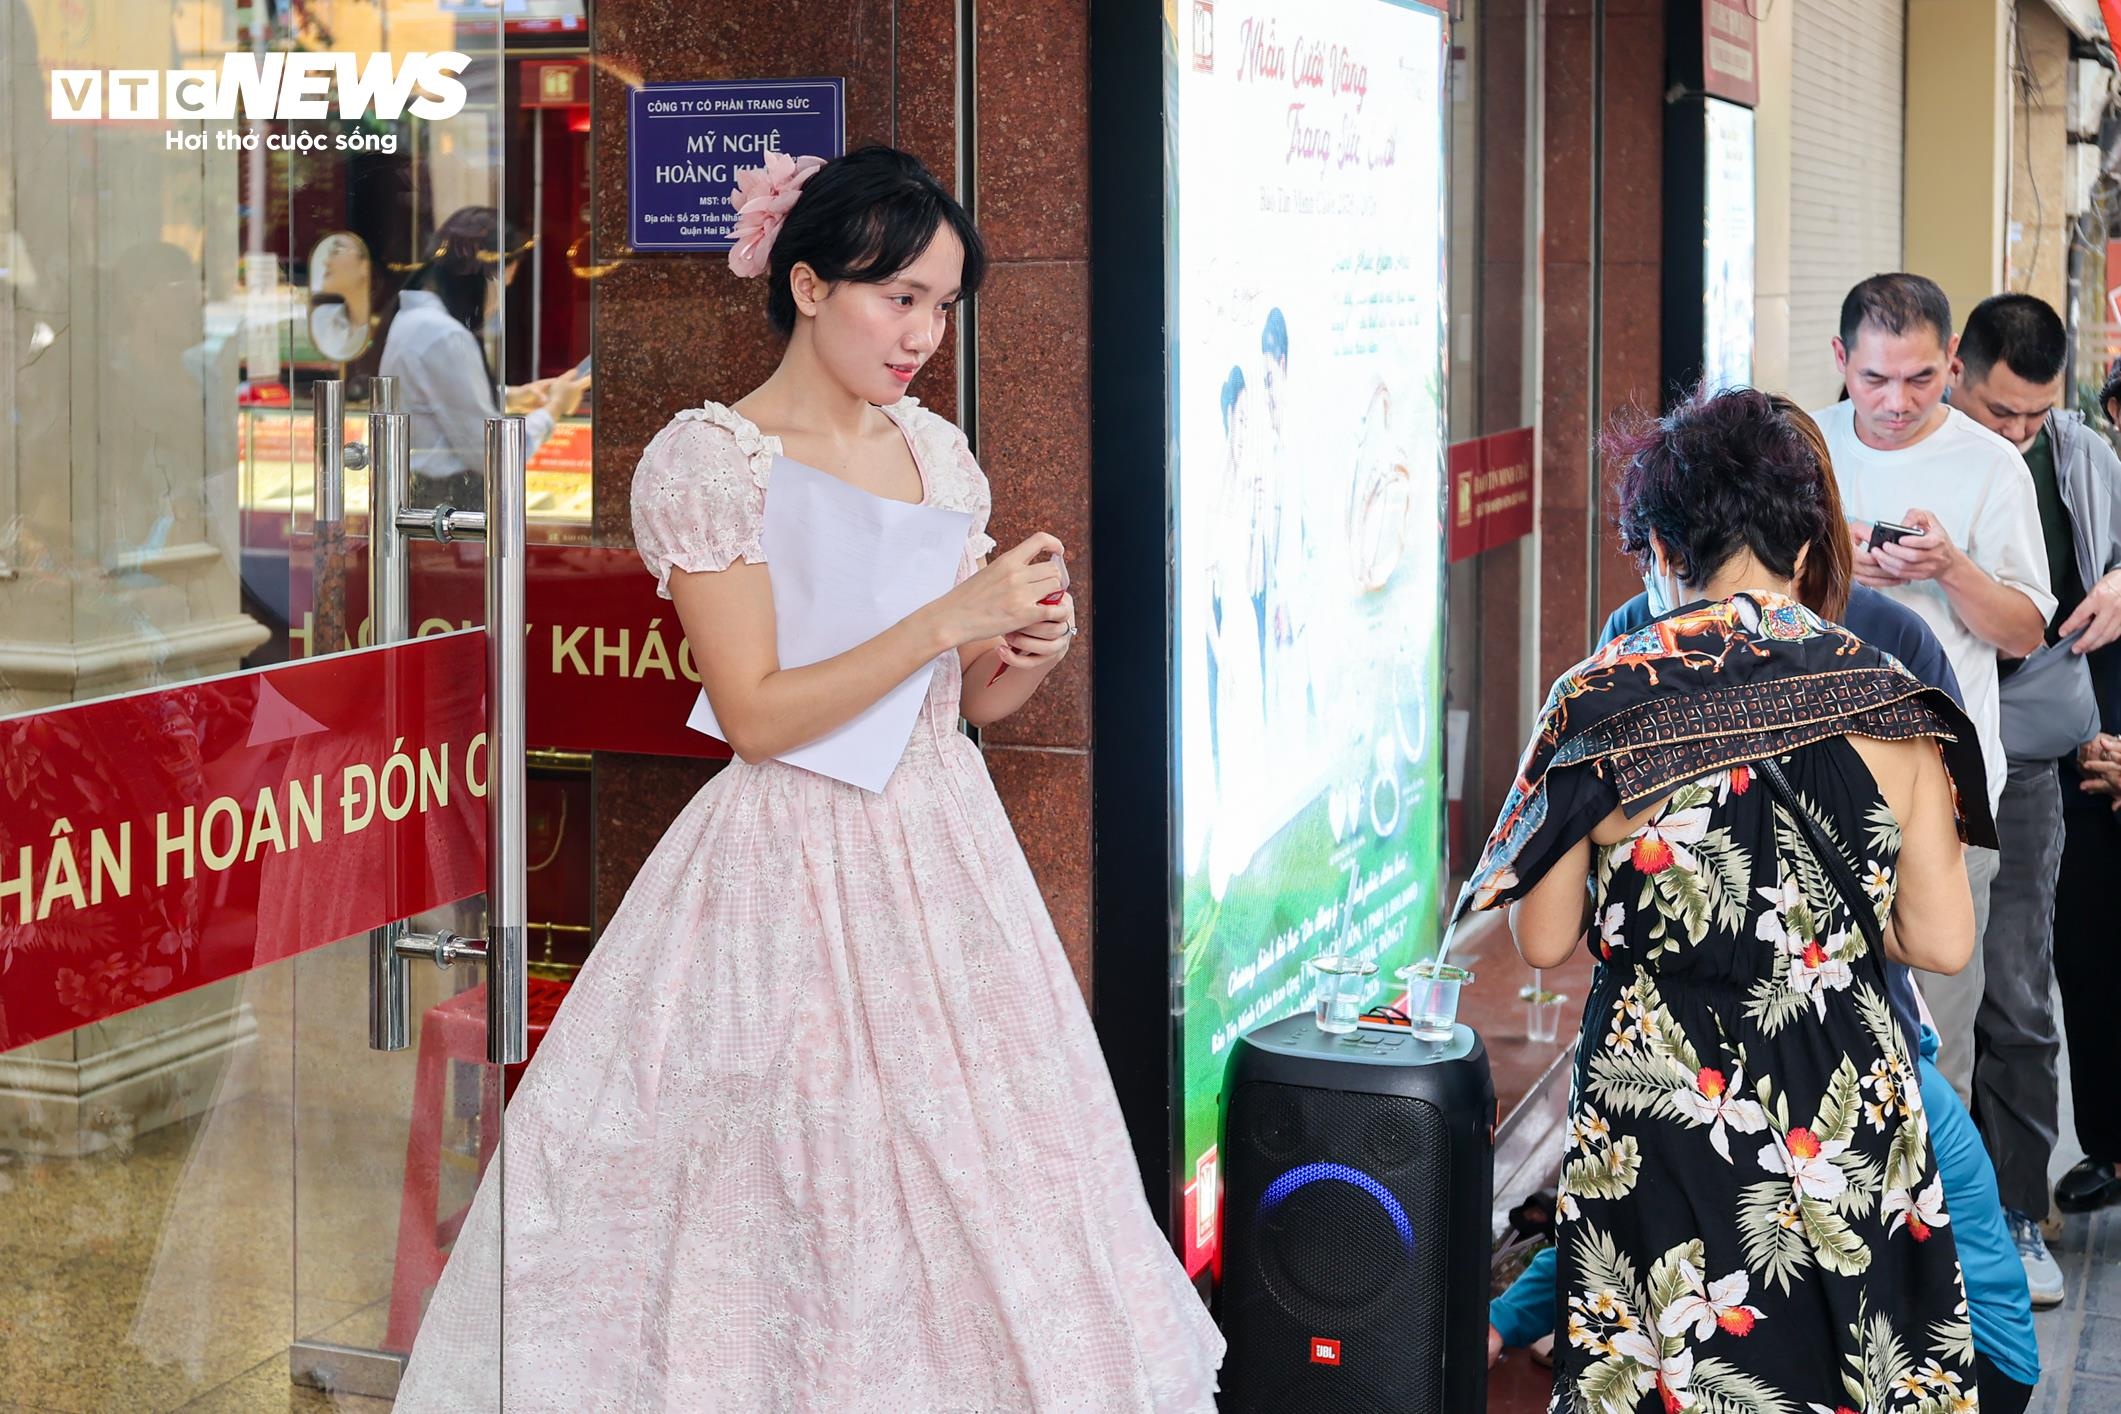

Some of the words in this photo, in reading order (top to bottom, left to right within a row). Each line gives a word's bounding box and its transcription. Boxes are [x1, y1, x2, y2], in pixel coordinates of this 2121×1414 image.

[647, 100, 678, 113] CÔNG
[681, 101, 694, 112] TY
[747, 99, 783, 110] TRANG
[786, 96, 810, 109] SỨC
[686, 130, 716, 153] MỸ
[656, 160, 727, 183] HOÀNG
[699, 196, 719, 206] MST:
[644, 214, 658, 224] Địa
[677, 212, 689, 222] Số
[690, 213, 700, 222] 29
[701, 212, 720, 222] Trần
[680, 226, 702, 236] Quận
[703, 226, 718, 235] Hai
[719, 226, 731, 235] Bà
[156, 773, 323, 887] HOAN
[340, 736, 449, 835] ĐÓN
[1315, 1344, 1336, 1360] JBL
